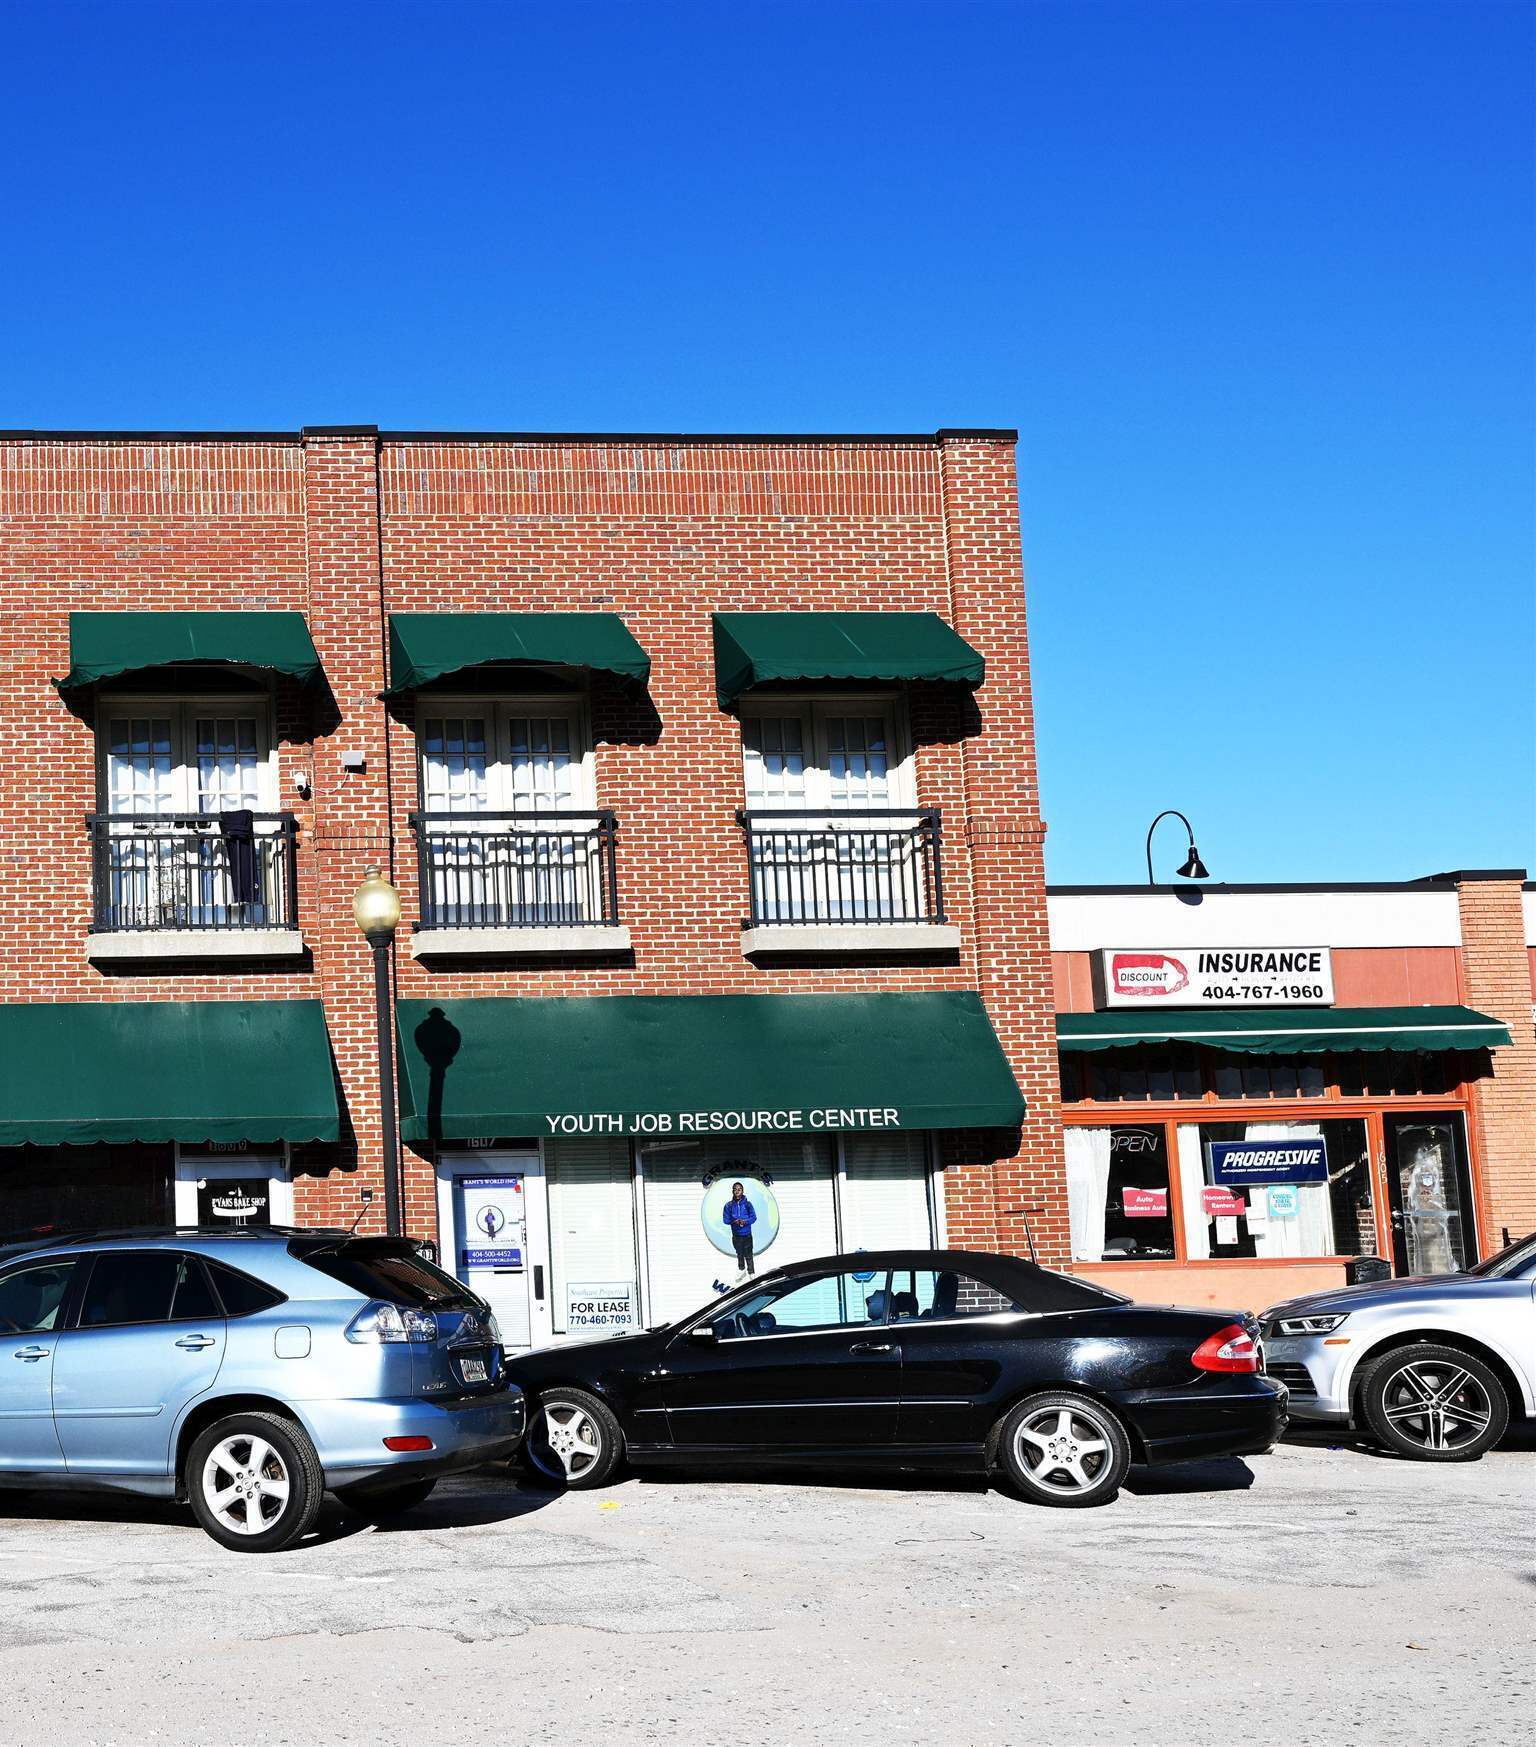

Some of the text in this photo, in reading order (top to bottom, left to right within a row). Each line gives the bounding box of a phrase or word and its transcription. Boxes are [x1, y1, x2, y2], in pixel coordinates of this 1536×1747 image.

[1198, 952, 1322, 973] INSURANCE
[1120, 972, 1168, 982] DISCOUNT
[1202, 985, 1324, 999] 404-767-1960
[545, 1108, 900, 1133] YOUTH JOB RESOURCE CENTER
[1222, 1149, 1322, 1168] PROGRESSIVE
[250, 1197, 266, 1206] SHOP
[472, 1250, 511, 1258] 404-500-4452
[570, 1301, 630, 1313] FOR LEASE
[569, 1315, 632, 1325] 770-460-7093
